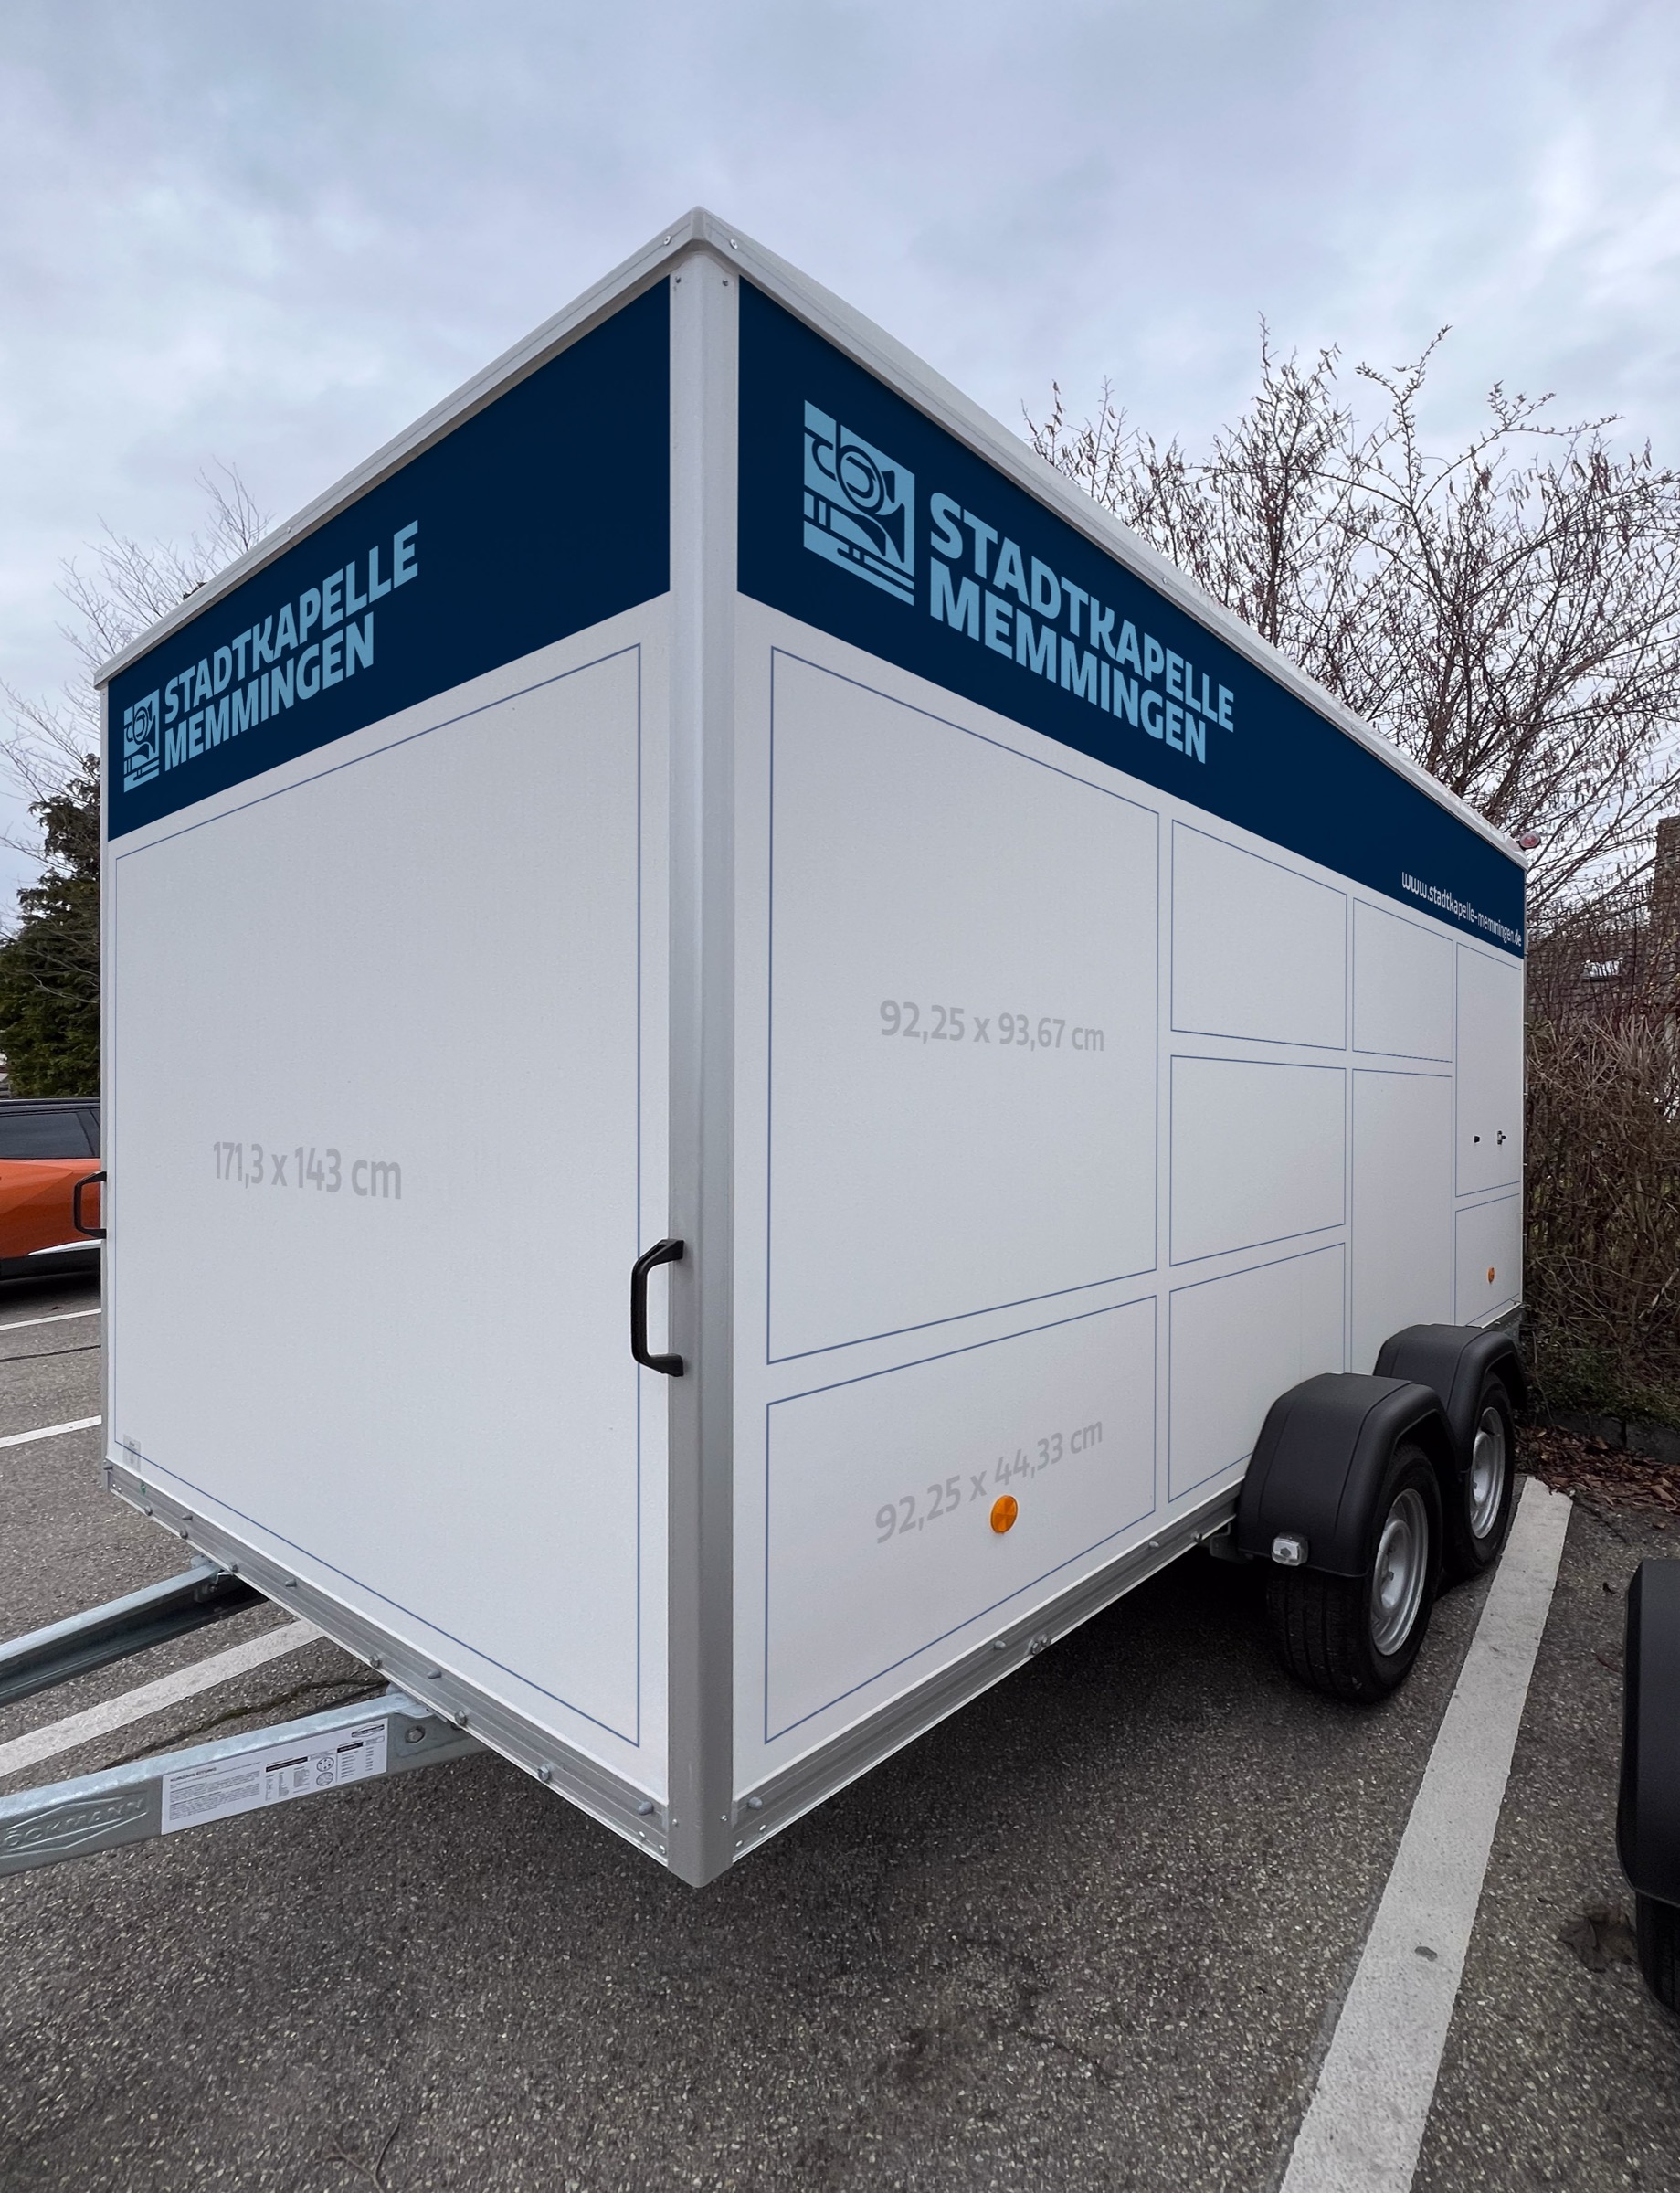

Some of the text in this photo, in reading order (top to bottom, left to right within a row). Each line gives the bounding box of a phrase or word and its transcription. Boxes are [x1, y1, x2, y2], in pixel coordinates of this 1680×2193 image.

[164, 519, 418, 724] STADTKAPELLE
[930, 492, 1234, 733] STADTKAPELLE
[930, 556, 1206, 765] MEMMINGEN
[164, 611, 374, 772] MEMMINGEN
[1401, 871, 1522, 948] www.stadtkapelle-memmingen.de
[879, 999, 1104, 1052] 92,25 x 93,67 cm
[213, 1141, 402, 1200] 171,3 x 143 cm
[875, 1421, 1103, 1544] 92,25 x 44,33 cm
